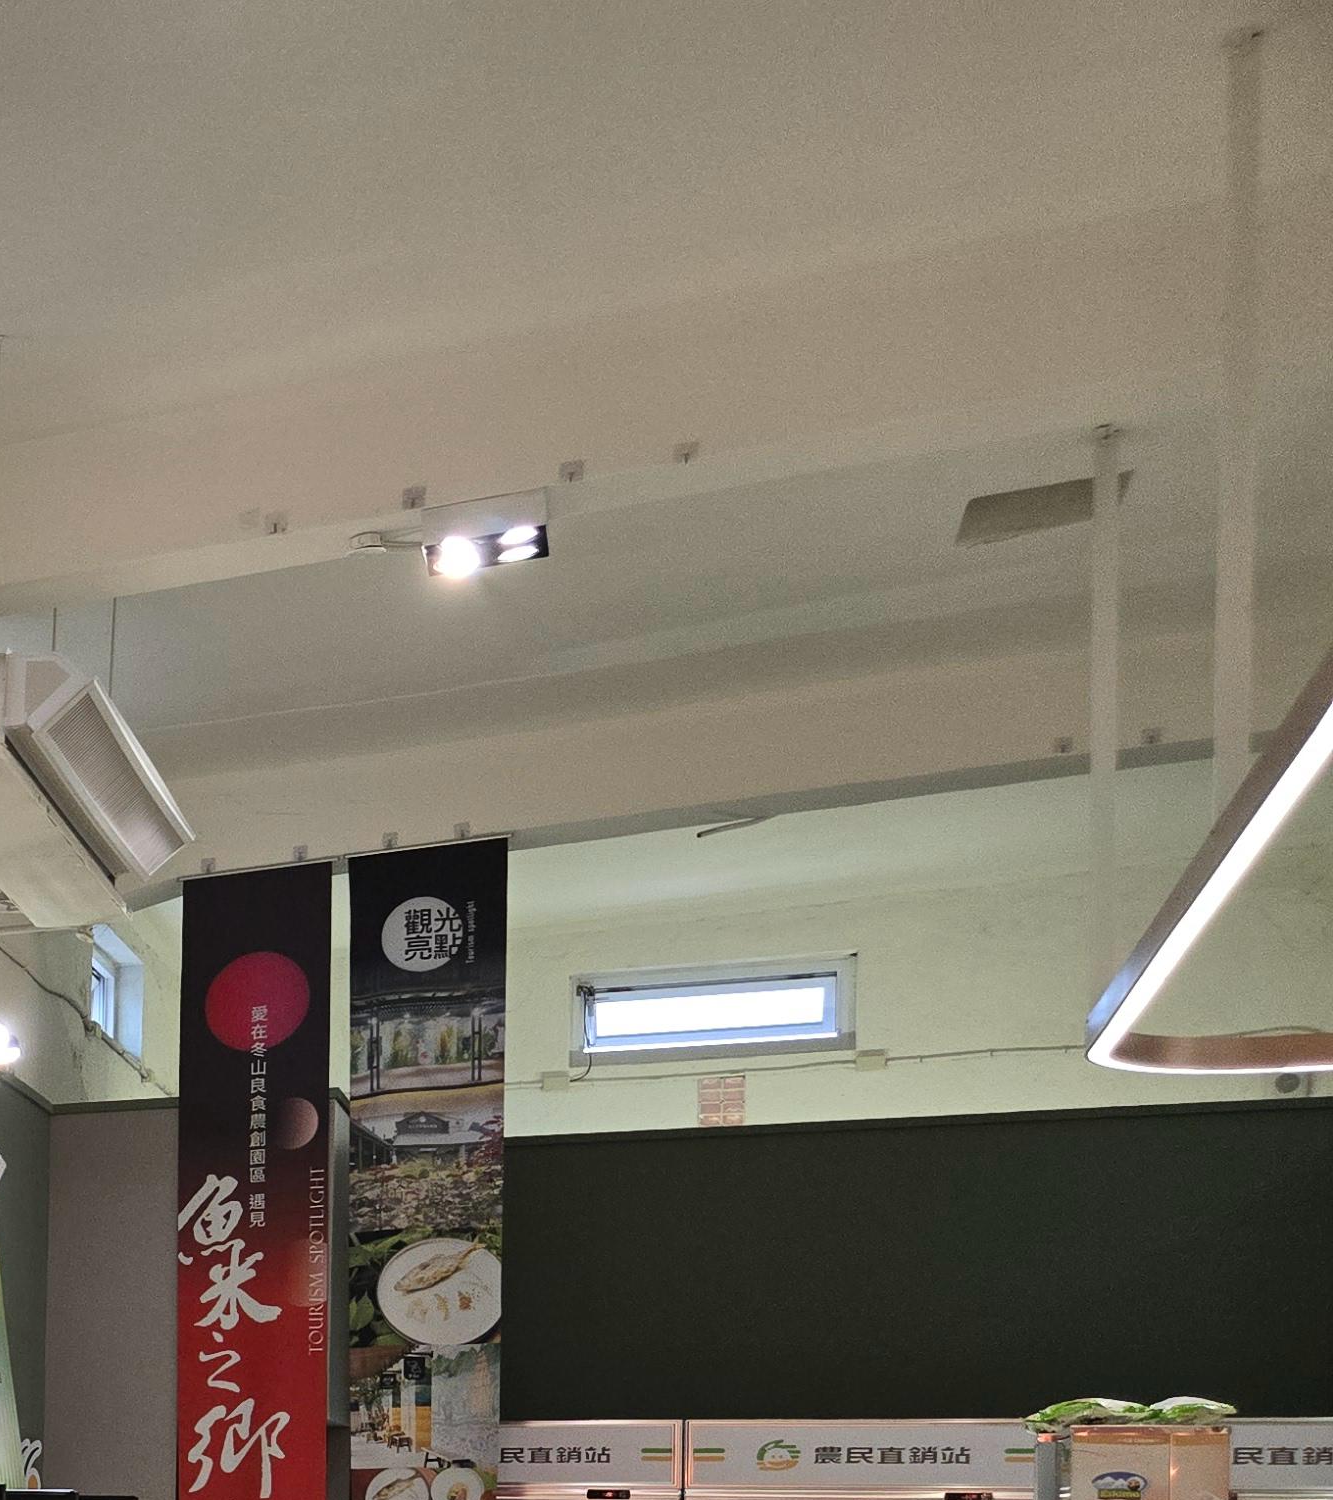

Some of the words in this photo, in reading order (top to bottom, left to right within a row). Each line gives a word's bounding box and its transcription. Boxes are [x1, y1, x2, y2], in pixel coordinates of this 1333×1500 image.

[404, 907, 462, 935] 觀光
[405, 933, 461, 961] 亮點
[249, 1005, 268, 1183] 愛在冬山良食農創園區
[249, 1194, 266, 1228] 遇見
[309, 1167, 325, 1264] SPOTLIGHT
[309, 1273, 325, 1355] TOURISM
[814, 1446, 971, 1465] 農民直銷站
